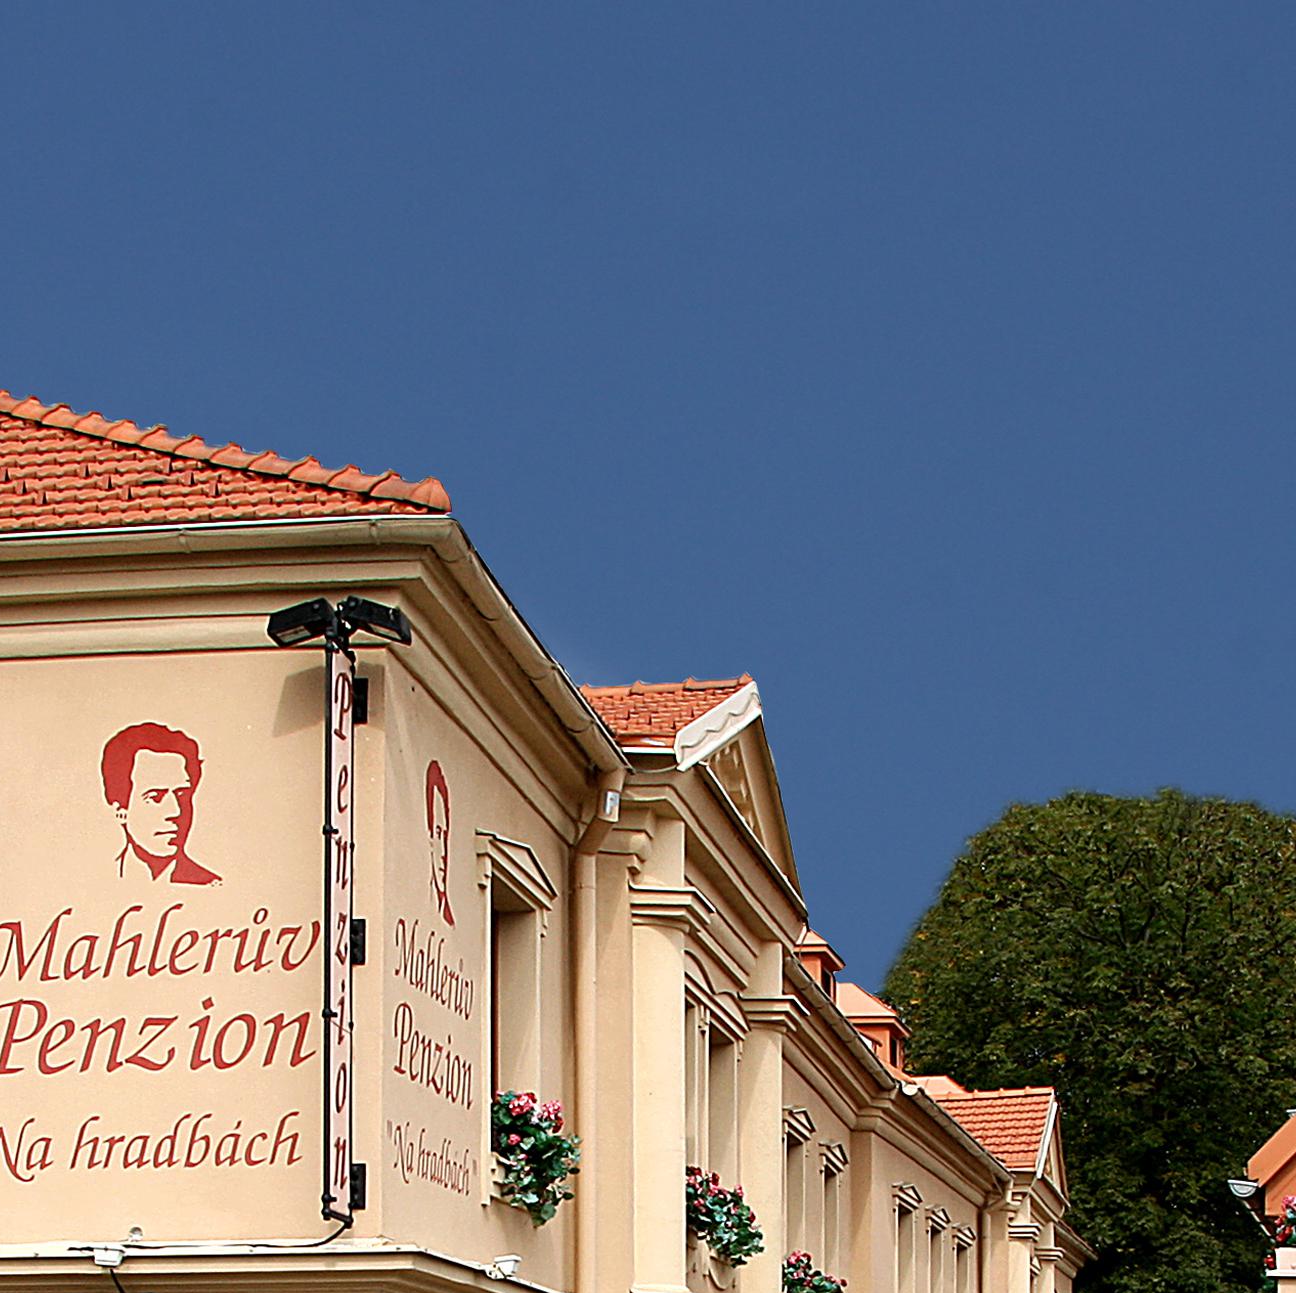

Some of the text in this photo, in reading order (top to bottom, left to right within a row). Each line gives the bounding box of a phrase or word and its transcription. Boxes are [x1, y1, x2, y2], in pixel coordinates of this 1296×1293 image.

[333, 671, 353, 1190] Penzion
[394, 918, 473, 1020] Mahlerův
[393, 1002, 472, 1110] Penzion
